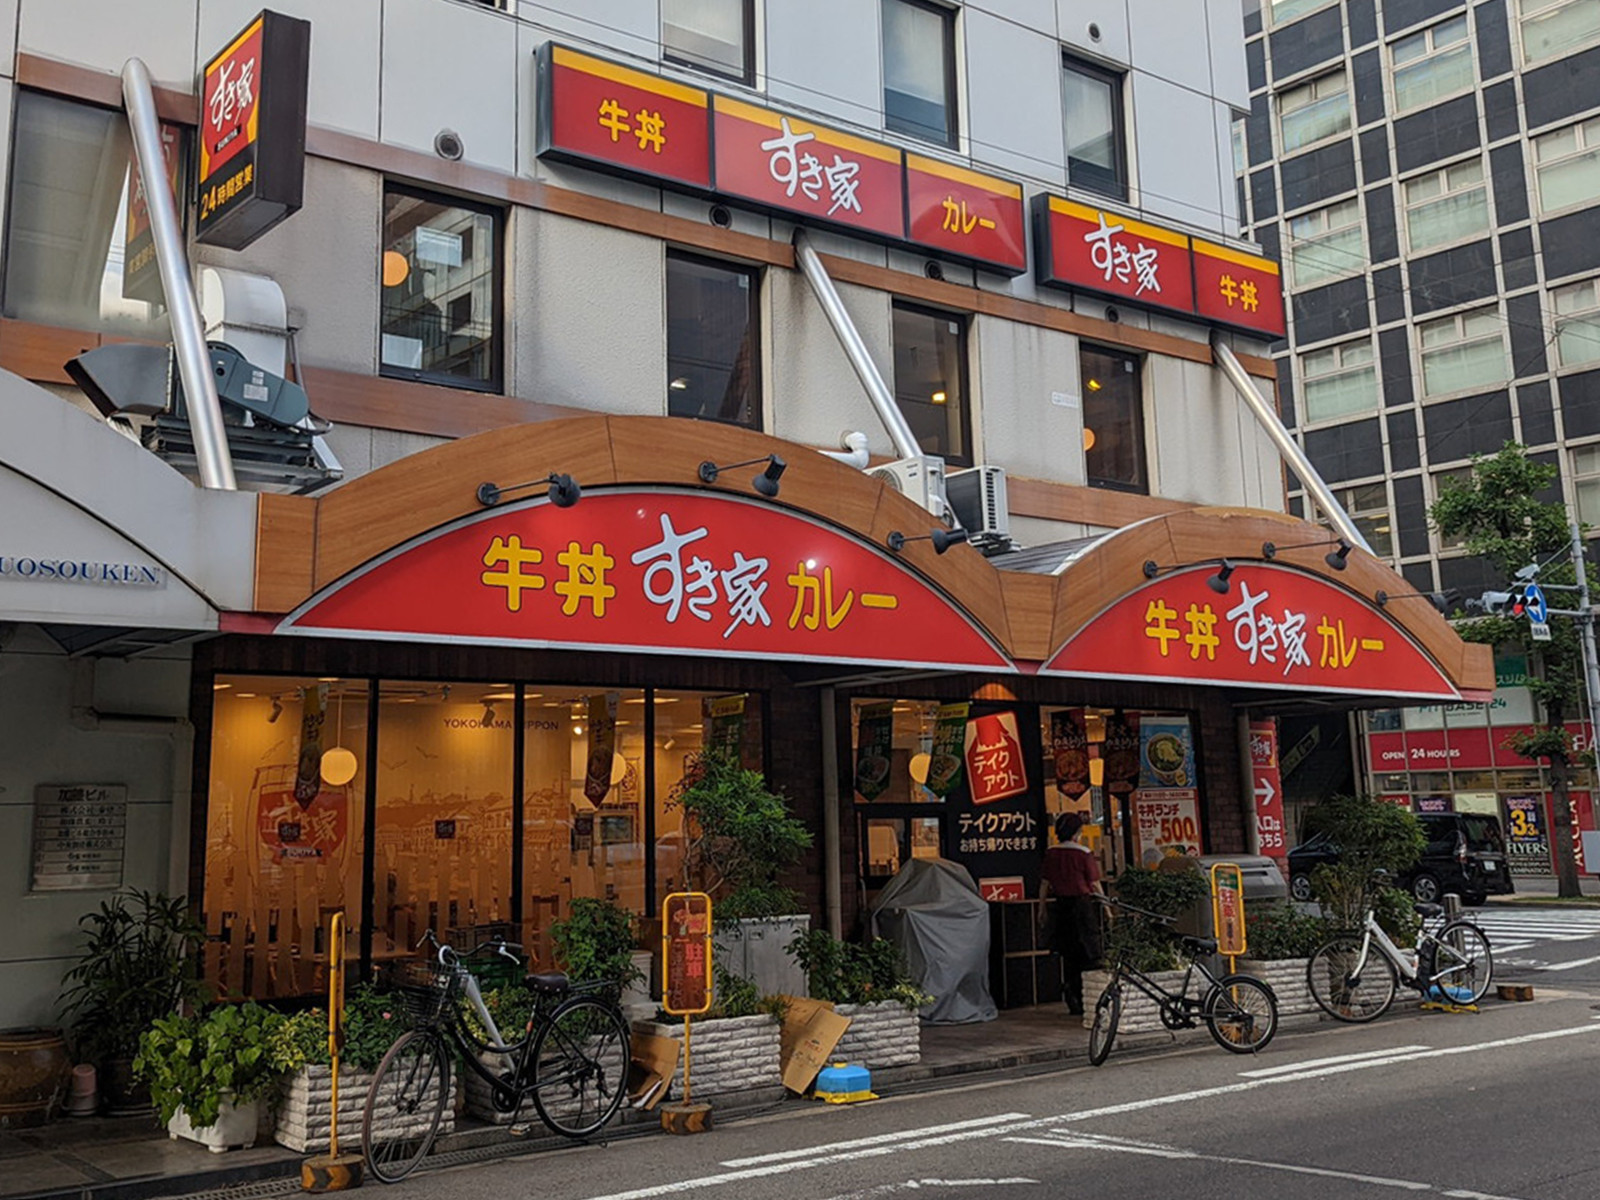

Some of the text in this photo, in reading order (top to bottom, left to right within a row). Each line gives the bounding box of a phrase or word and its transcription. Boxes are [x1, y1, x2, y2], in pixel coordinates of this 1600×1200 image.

[210, 57, 256, 132] すき家
[598, 99, 666, 154] 牛丼
[761, 116, 863, 216] すき家
[201, 164, 253, 220] 24時間営業
[942, 194, 996, 235] カレー
[1084, 211, 1161, 297] すき家
[1219, 274, 1259, 313] 牛丼
[481, 512, 898, 640] 牛丼 すき家 カレー
[1144, 580, 1385, 676] 牛丼 すき家 カレー
[1490, 698, 1507, 709] 24
[973, 750, 1010, 775] テイク
[1382, 748, 1461, 760] OPEN 24 HOURS
[982, 770, 1020, 794] アウト
[958, 811, 1037, 835] テイクアウト
[1138, 803, 1180, 817] 牛丼ランチ
[959, 836, 1037, 854] お持ち帰りできます
[1160, 816, 1195, 844] 500
[1506, 842, 1548, 855] FLYERS
